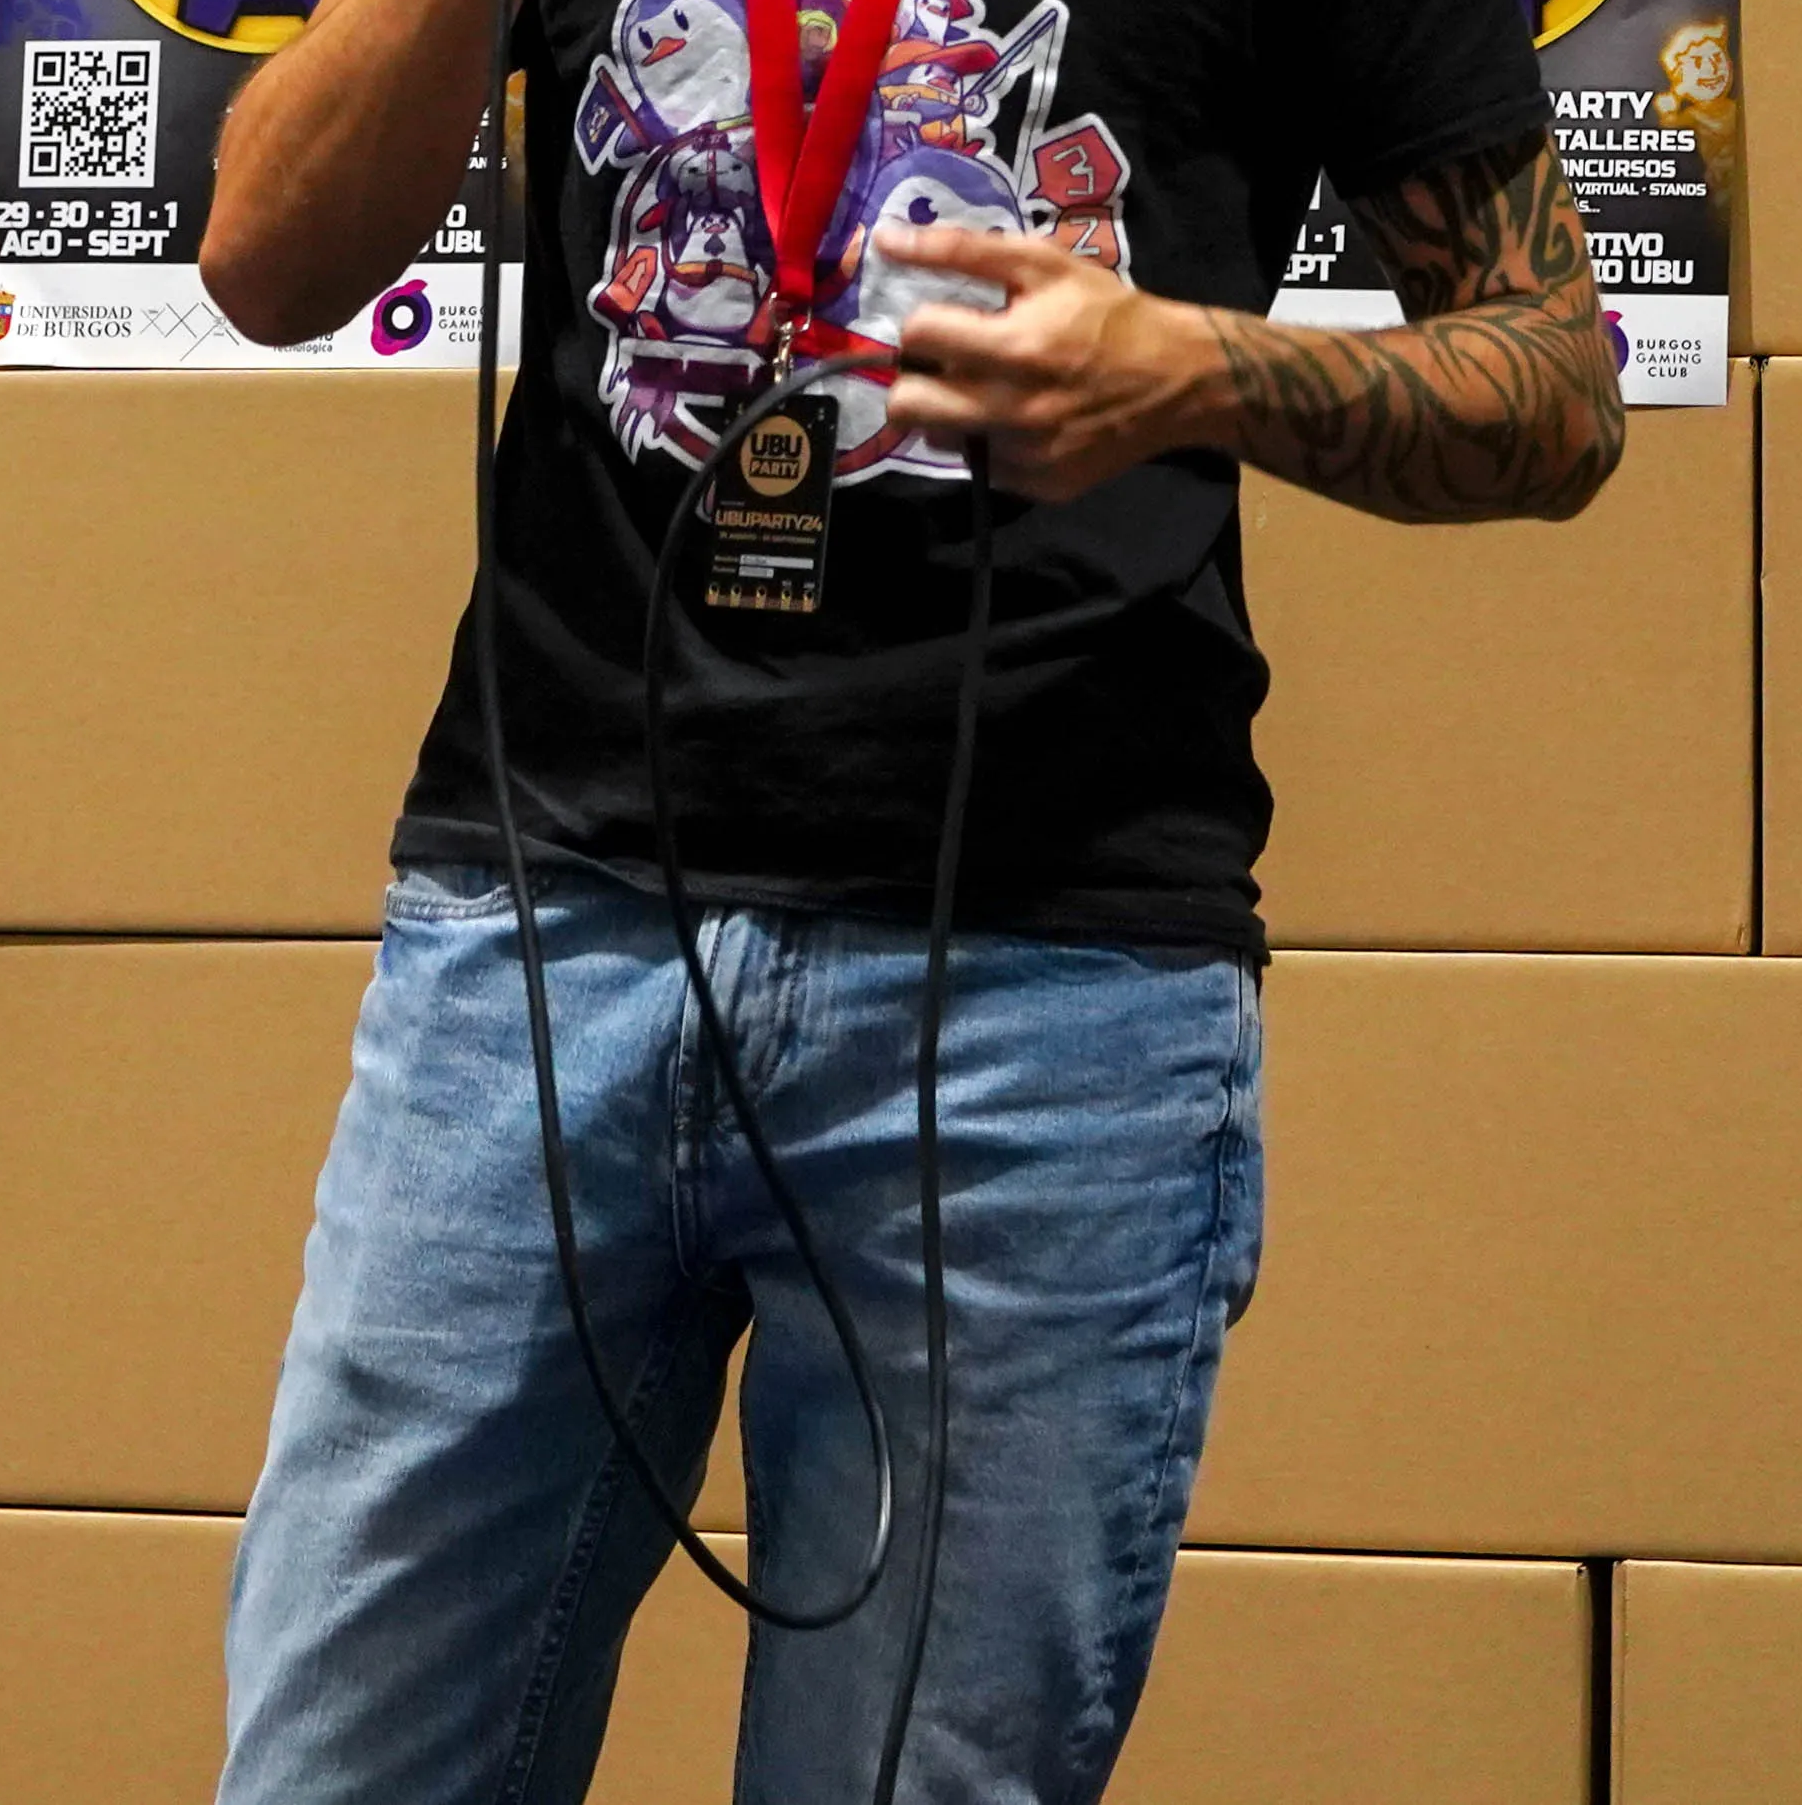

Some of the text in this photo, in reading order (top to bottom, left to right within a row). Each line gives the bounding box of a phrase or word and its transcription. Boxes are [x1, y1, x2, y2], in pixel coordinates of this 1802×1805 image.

[1548, 90, 1654, 120] ARTY
[1554, 128, 1696, 153] TALLERES
[1562, 158, 1677, 179] NCURSOS
[1575, 183, 1639, 196] VIRTUAL
[1649, 183, 1707, 197] STANDS
[49, 201, 89, 228] 30
[109, 201, 142, 228] 31
[164, 201, 178, 229] 1
[0, 229, 62, 257] AGO
[88, 229, 170, 257] SEPT
[1331, 224, 1346, 252] 1
[1631, 259, 1695, 284] UBU
[19, 305, 132, 320] UNIVERSIDAD
[17, 320, 132, 338] DE BURGOS
[1636, 339, 1702, 351] BURGOS
[1636, 352, 1702, 364] GAMING
[1647, 366, 1688, 378] CLUB
[751, 432, 802, 457] UBU
[751, 460, 798, 478] PARTY
[715, 509, 823, 532] UBUPARTY24
